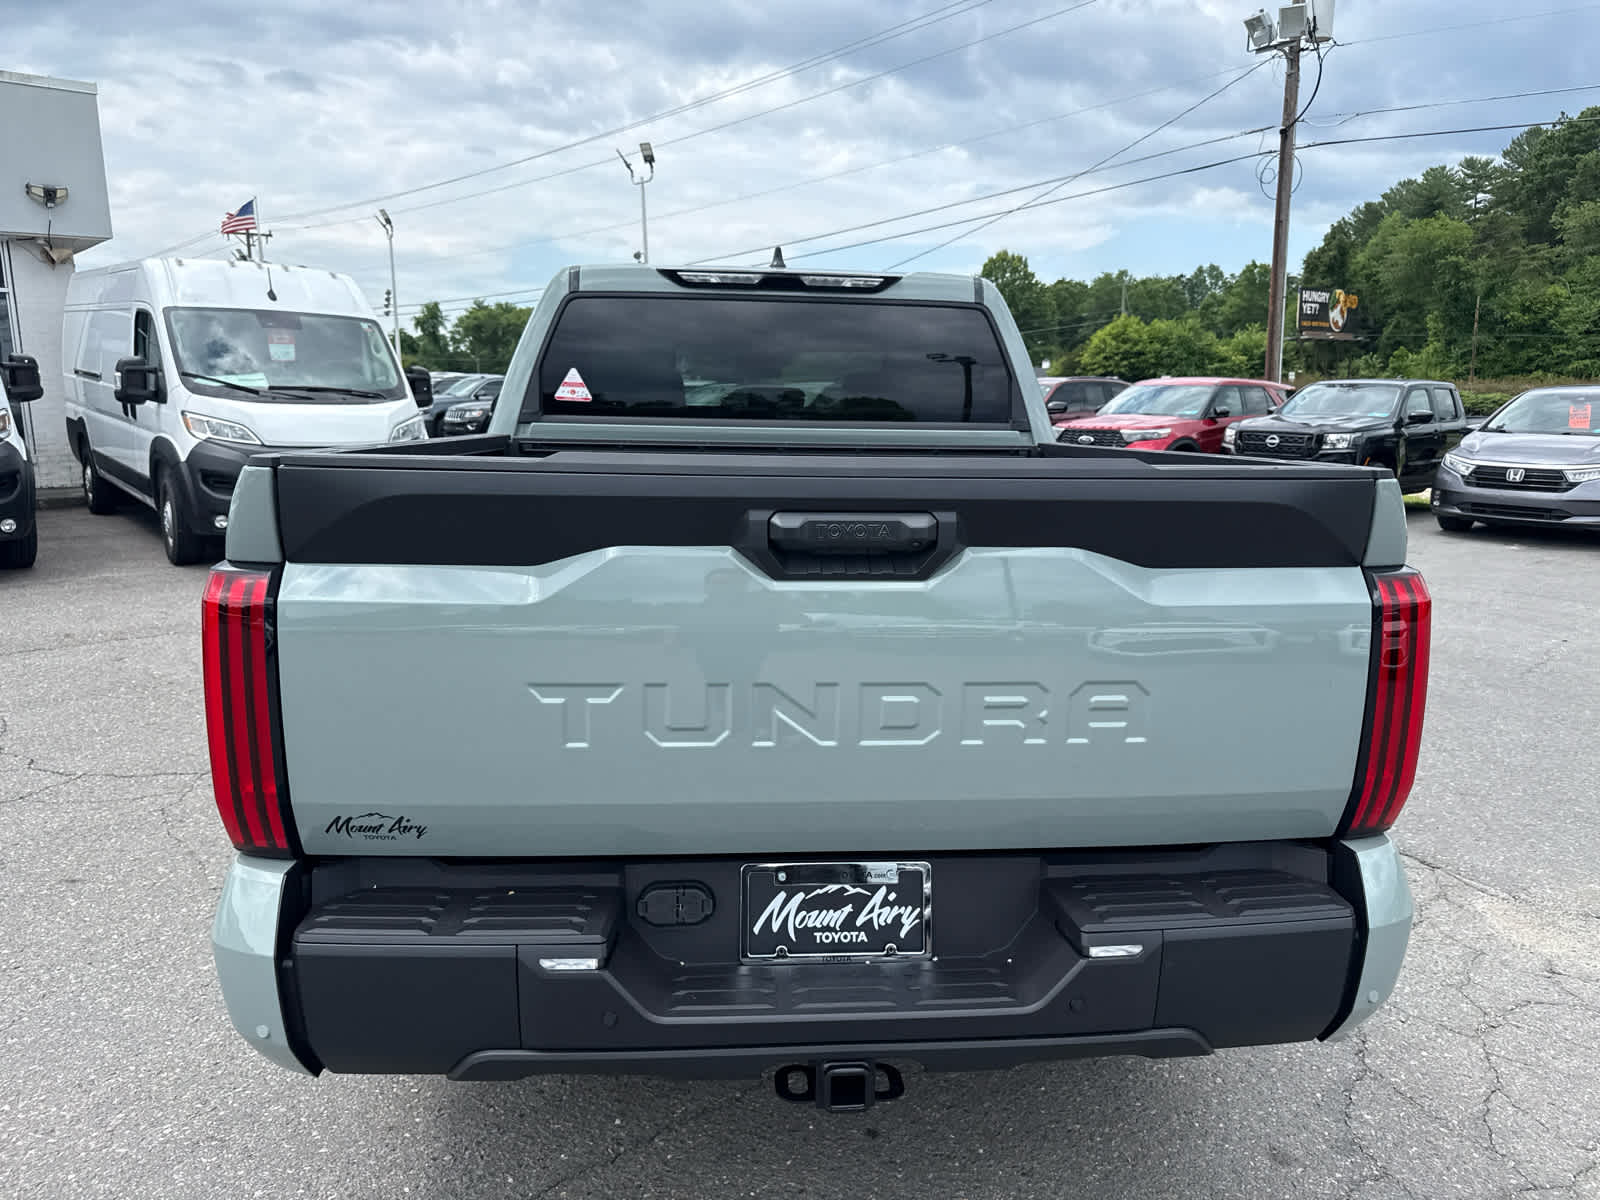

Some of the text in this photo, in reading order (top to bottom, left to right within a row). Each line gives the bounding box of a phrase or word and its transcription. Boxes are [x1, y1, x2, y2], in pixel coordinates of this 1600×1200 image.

[1302, 290, 1330, 303] HUNGRY
[1302, 303, 1320, 314] YET?
[815, 523, 891, 539] TOYOTA
[526, 680, 1151, 748] TUNDRA
[325, 815, 428, 839] Mount Airy
[752, 885, 921, 942] Mount Airy
[813, 931, 868, 944] TOYOTA
